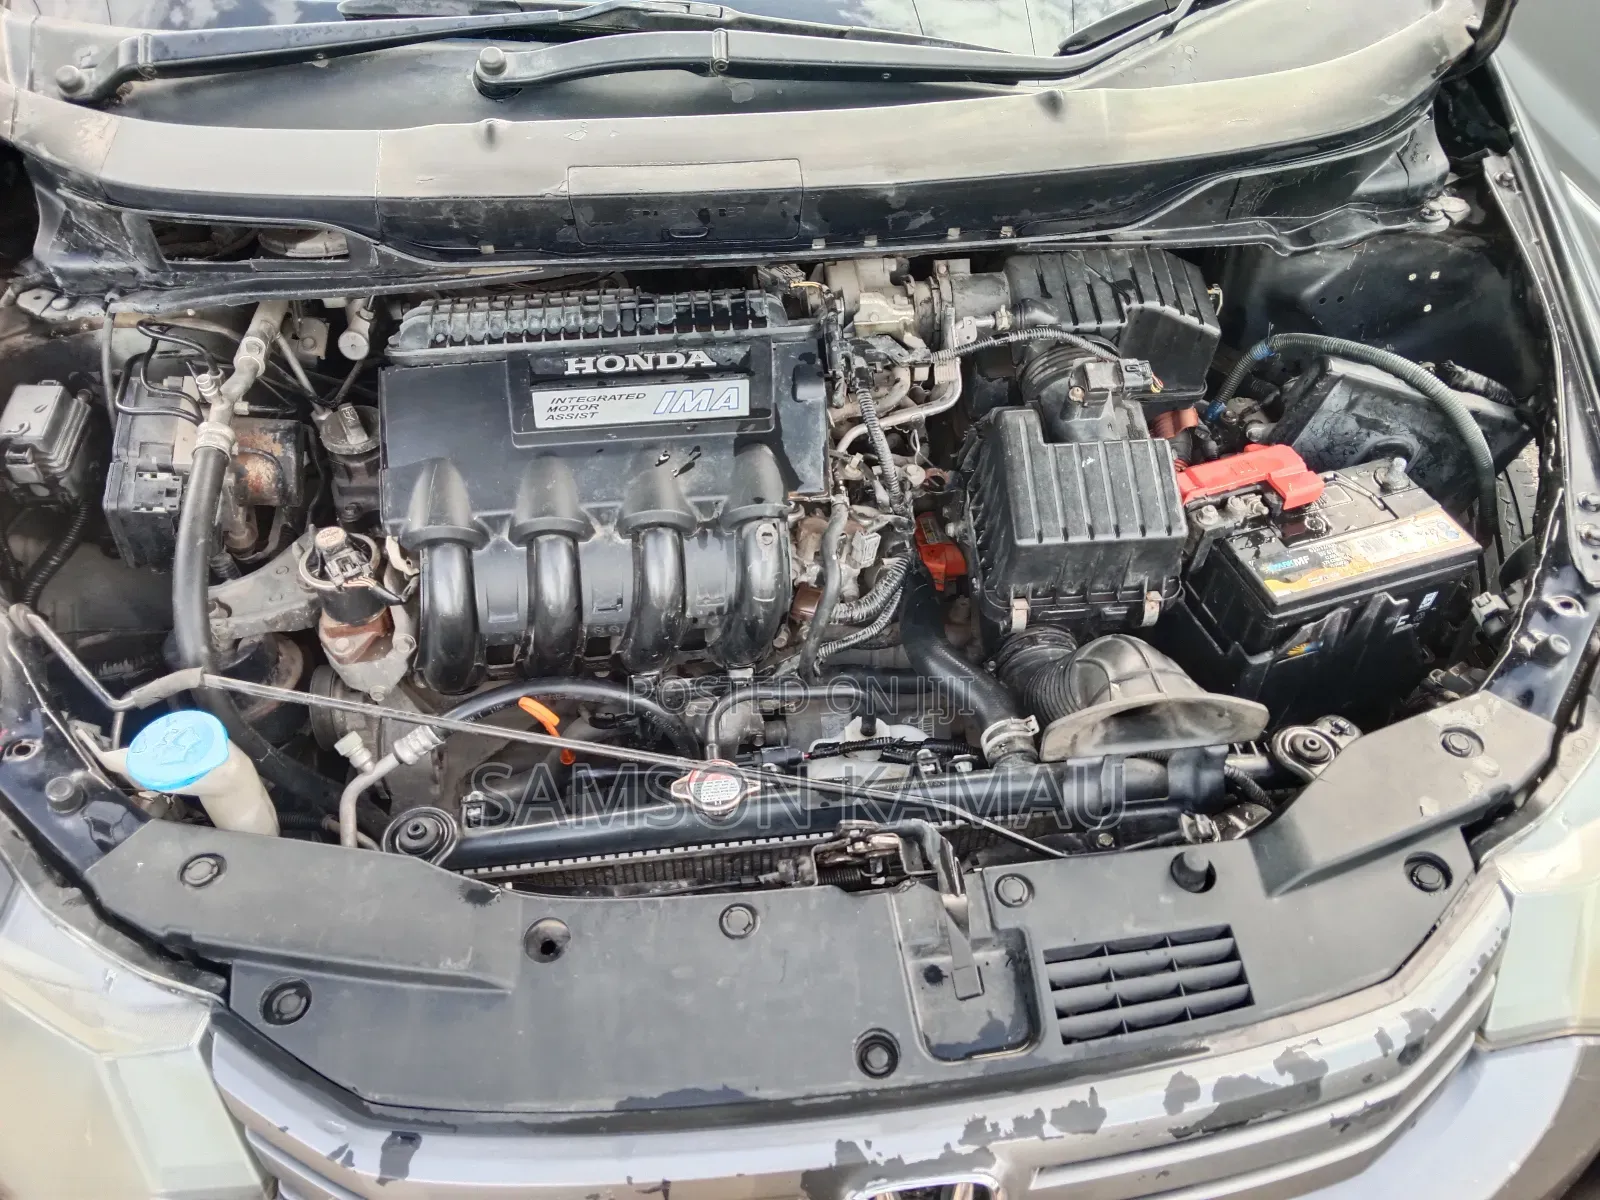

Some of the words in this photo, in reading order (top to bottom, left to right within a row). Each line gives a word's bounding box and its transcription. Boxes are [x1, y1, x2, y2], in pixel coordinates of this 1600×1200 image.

[564, 350, 716, 375] HONDA
[546, 403, 599, 413] MOTOR
[550, 392, 646, 405] INTEGRATED
[652, 387, 739, 415] IMA
[545, 412, 598, 421] ASSIST
